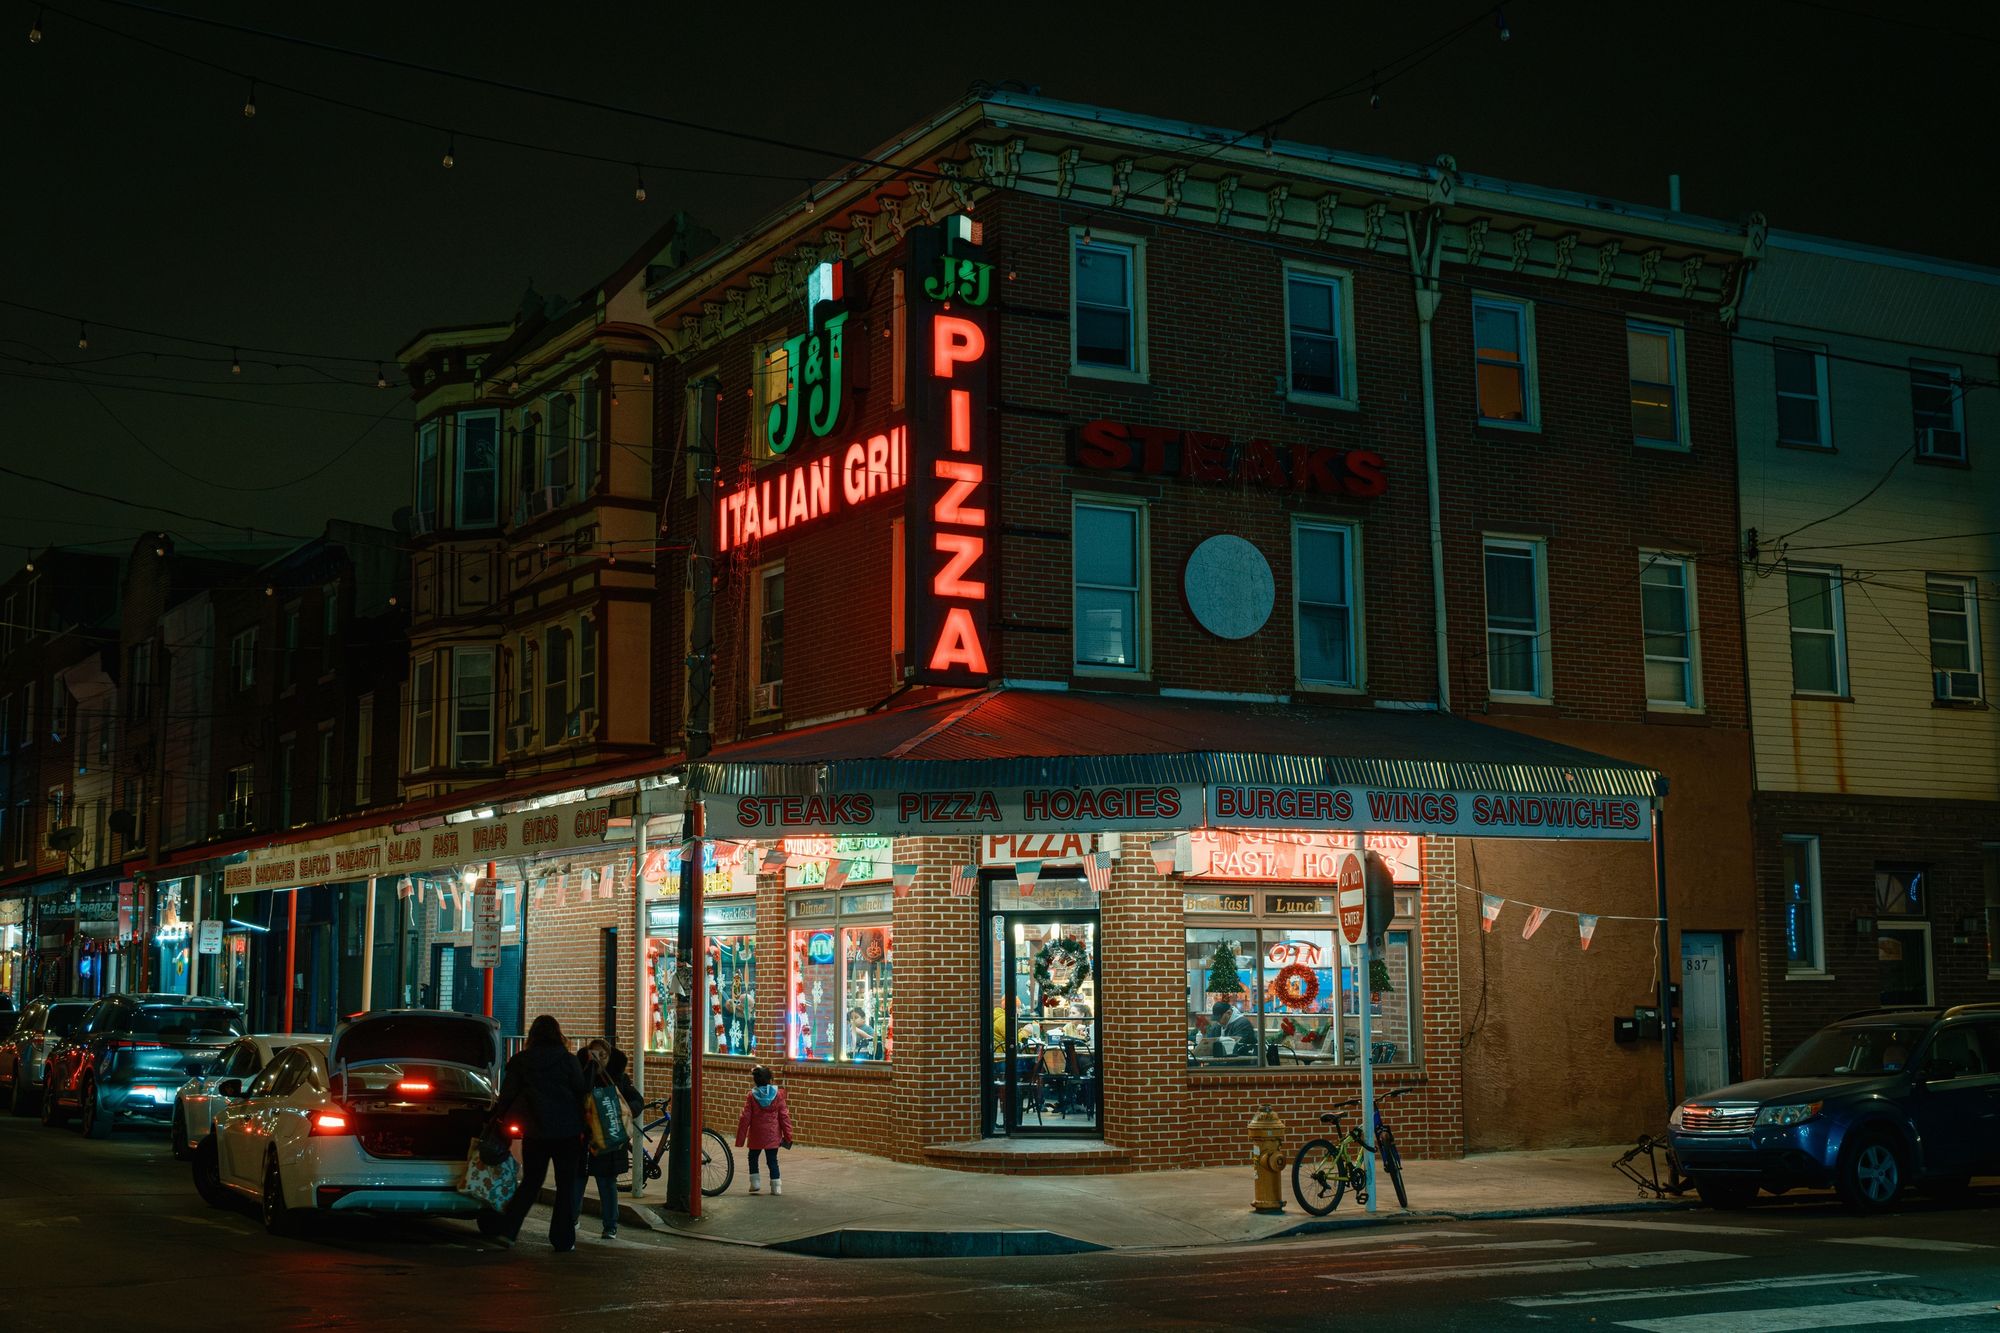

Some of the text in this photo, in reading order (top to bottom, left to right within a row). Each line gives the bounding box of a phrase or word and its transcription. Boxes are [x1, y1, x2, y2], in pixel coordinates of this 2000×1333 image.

[925, 256, 997, 306] J&J
[767, 311, 848, 454] J&J
[1079, 420, 1387, 497] STEAKS
[720, 456, 830, 552] ITALIAN
[930, 315, 988, 674] PIZZA
[737, 787, 1181, 827] STEAKS PIZZA HOAGIES
[1216, 786, 1641, 830] BURGERS WINGS SANDWICHES
[387, 837, 421, 865] SALADS
[432, 832, 459, 858] PASTA
[473, 823, 508, 852] WRAPS
[522, 814, 559, 845] GYROS
[990, 833, 1083, 858] PIZZA
[226, 845, 381, 889] BURGERS SANDWICHES SEAFOOD PANZAROTTI
[1342, 870, 1361, 887] DO NOT
[800, 902, 827, 914] Dinner
[1276, 898, 1322, 912] Lunch
[1344, 911, 1360, 926] ENTER
[809, 940, 835, 955] ATM
[1269, 944, 1322, 965] OPEN
[1686, 959, 1708, 971] 837
